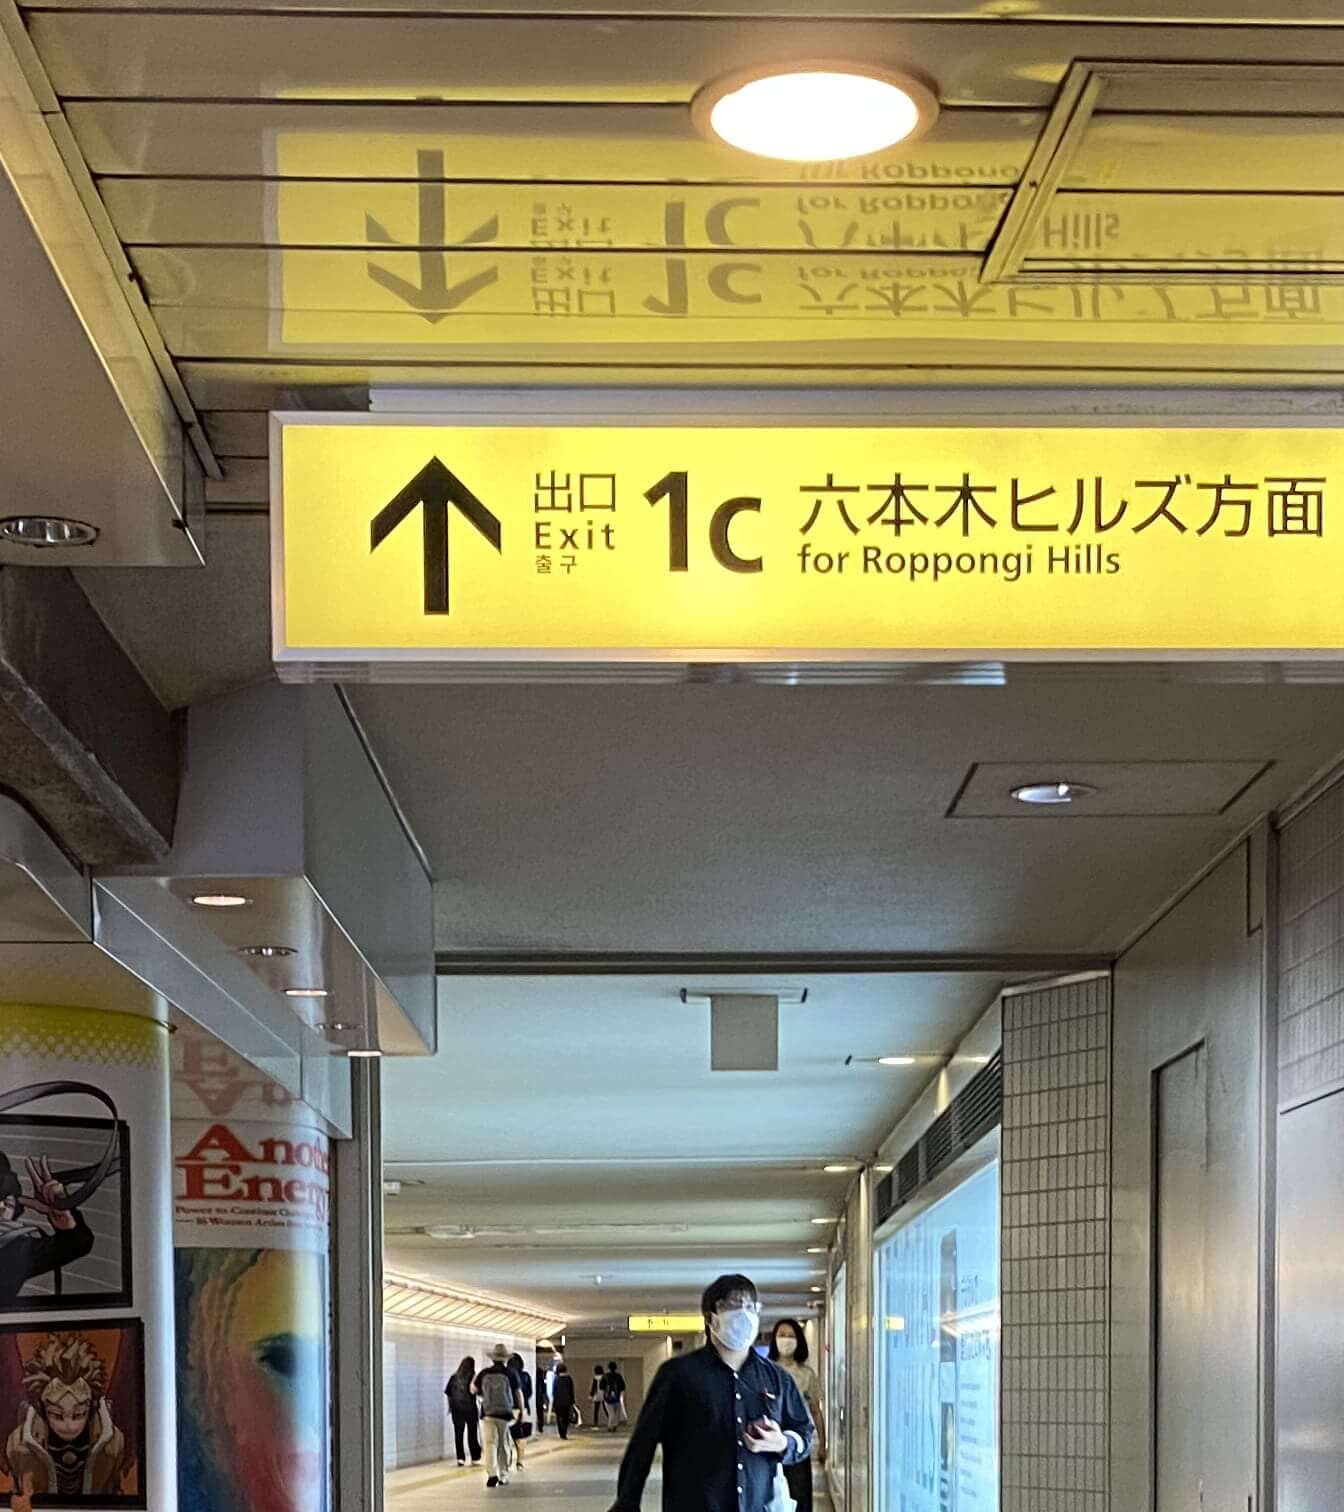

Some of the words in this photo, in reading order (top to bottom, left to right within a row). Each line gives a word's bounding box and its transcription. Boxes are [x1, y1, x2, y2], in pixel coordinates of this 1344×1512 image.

[534, 471, 618, 513] 出口
[798, 473, 1325, 539] 六本木ヒルズ方面
[534, 520, 617, 551] Exit
[643, 470, 763, 574] 1c
[798, 543, 853, 575] for
[862, 543, 1036, 583] Roppongi
[1047, 543, 1121, 575] Hills
